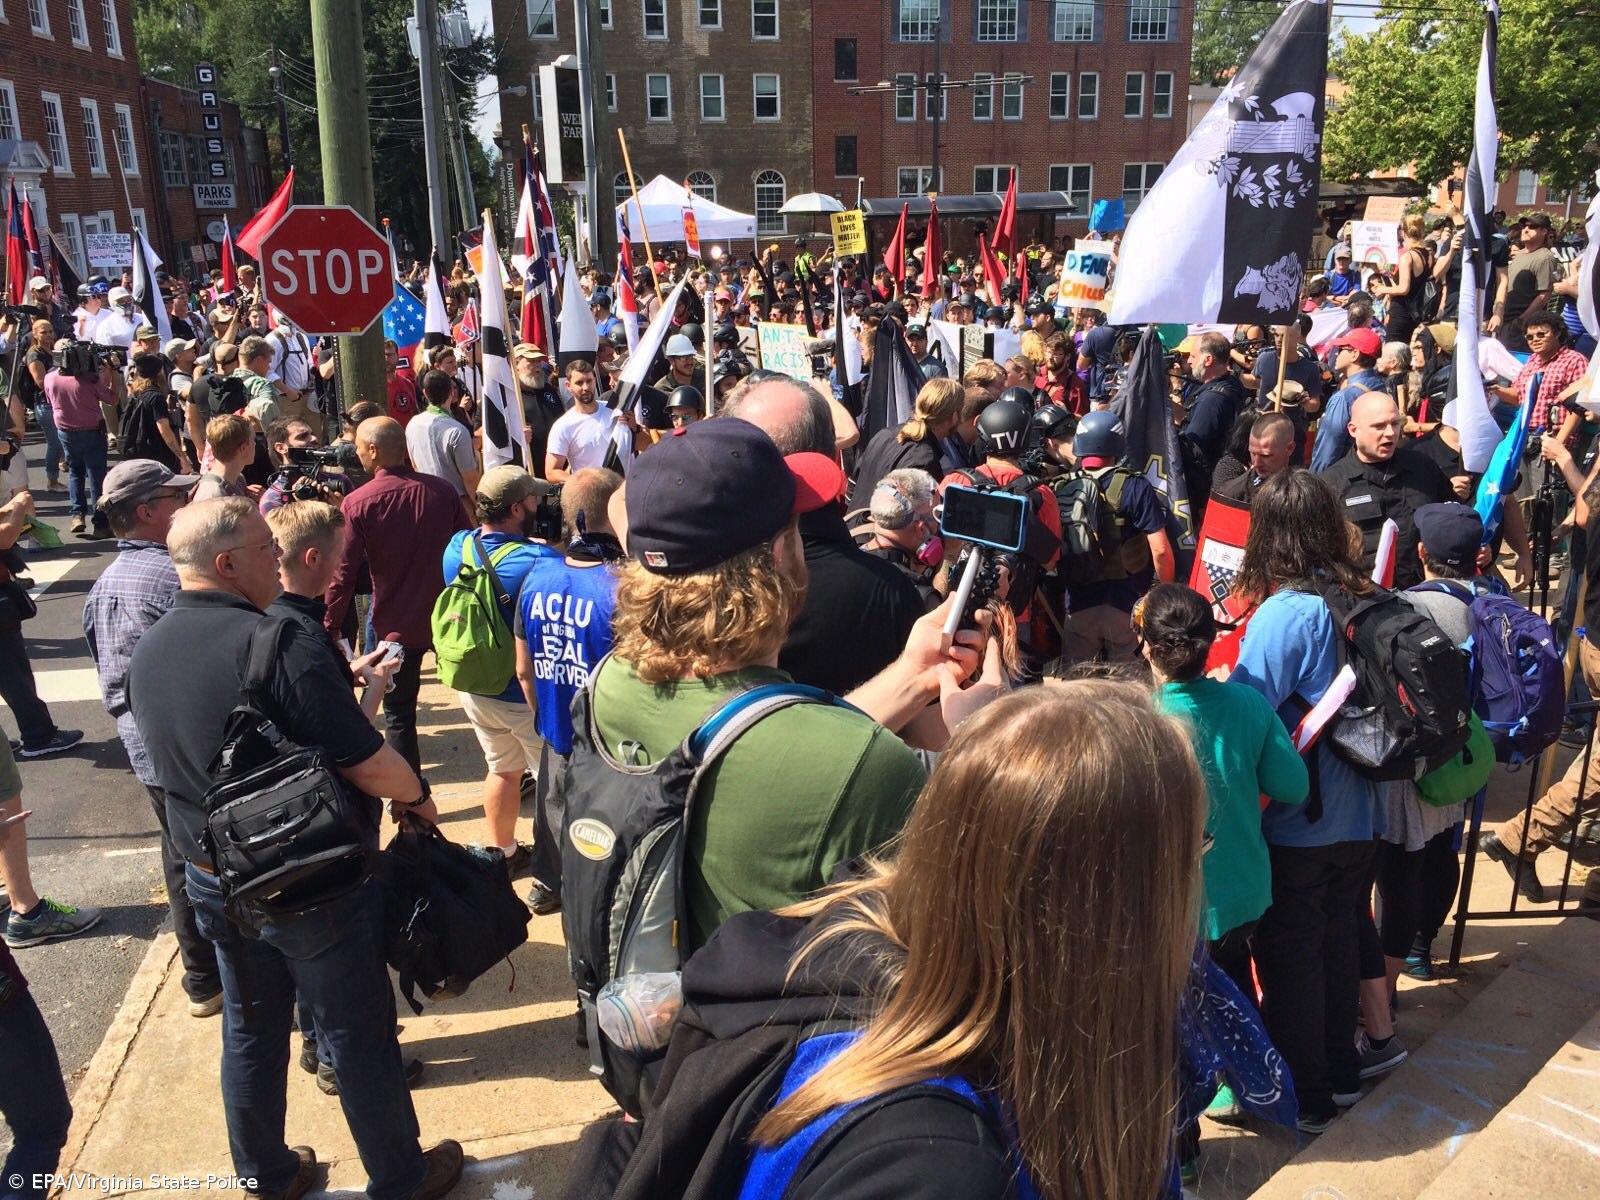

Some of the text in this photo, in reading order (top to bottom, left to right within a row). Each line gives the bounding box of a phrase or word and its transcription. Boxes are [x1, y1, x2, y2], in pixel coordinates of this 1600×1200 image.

[199, 69, 225, 176] GAUSS
[197, 186, 232, 199] PARKS
[507, 163, 515, 208] Downtown
[837, 215, 857, 223] BLACK
[840, 223, 856, 232] LIVES
[838, 233, 861, 242] MATTER
[271, 248, 384, 295] STOP
[991, 430, 1019, 450] TV
[530, 591, 594, 628] ACLU
